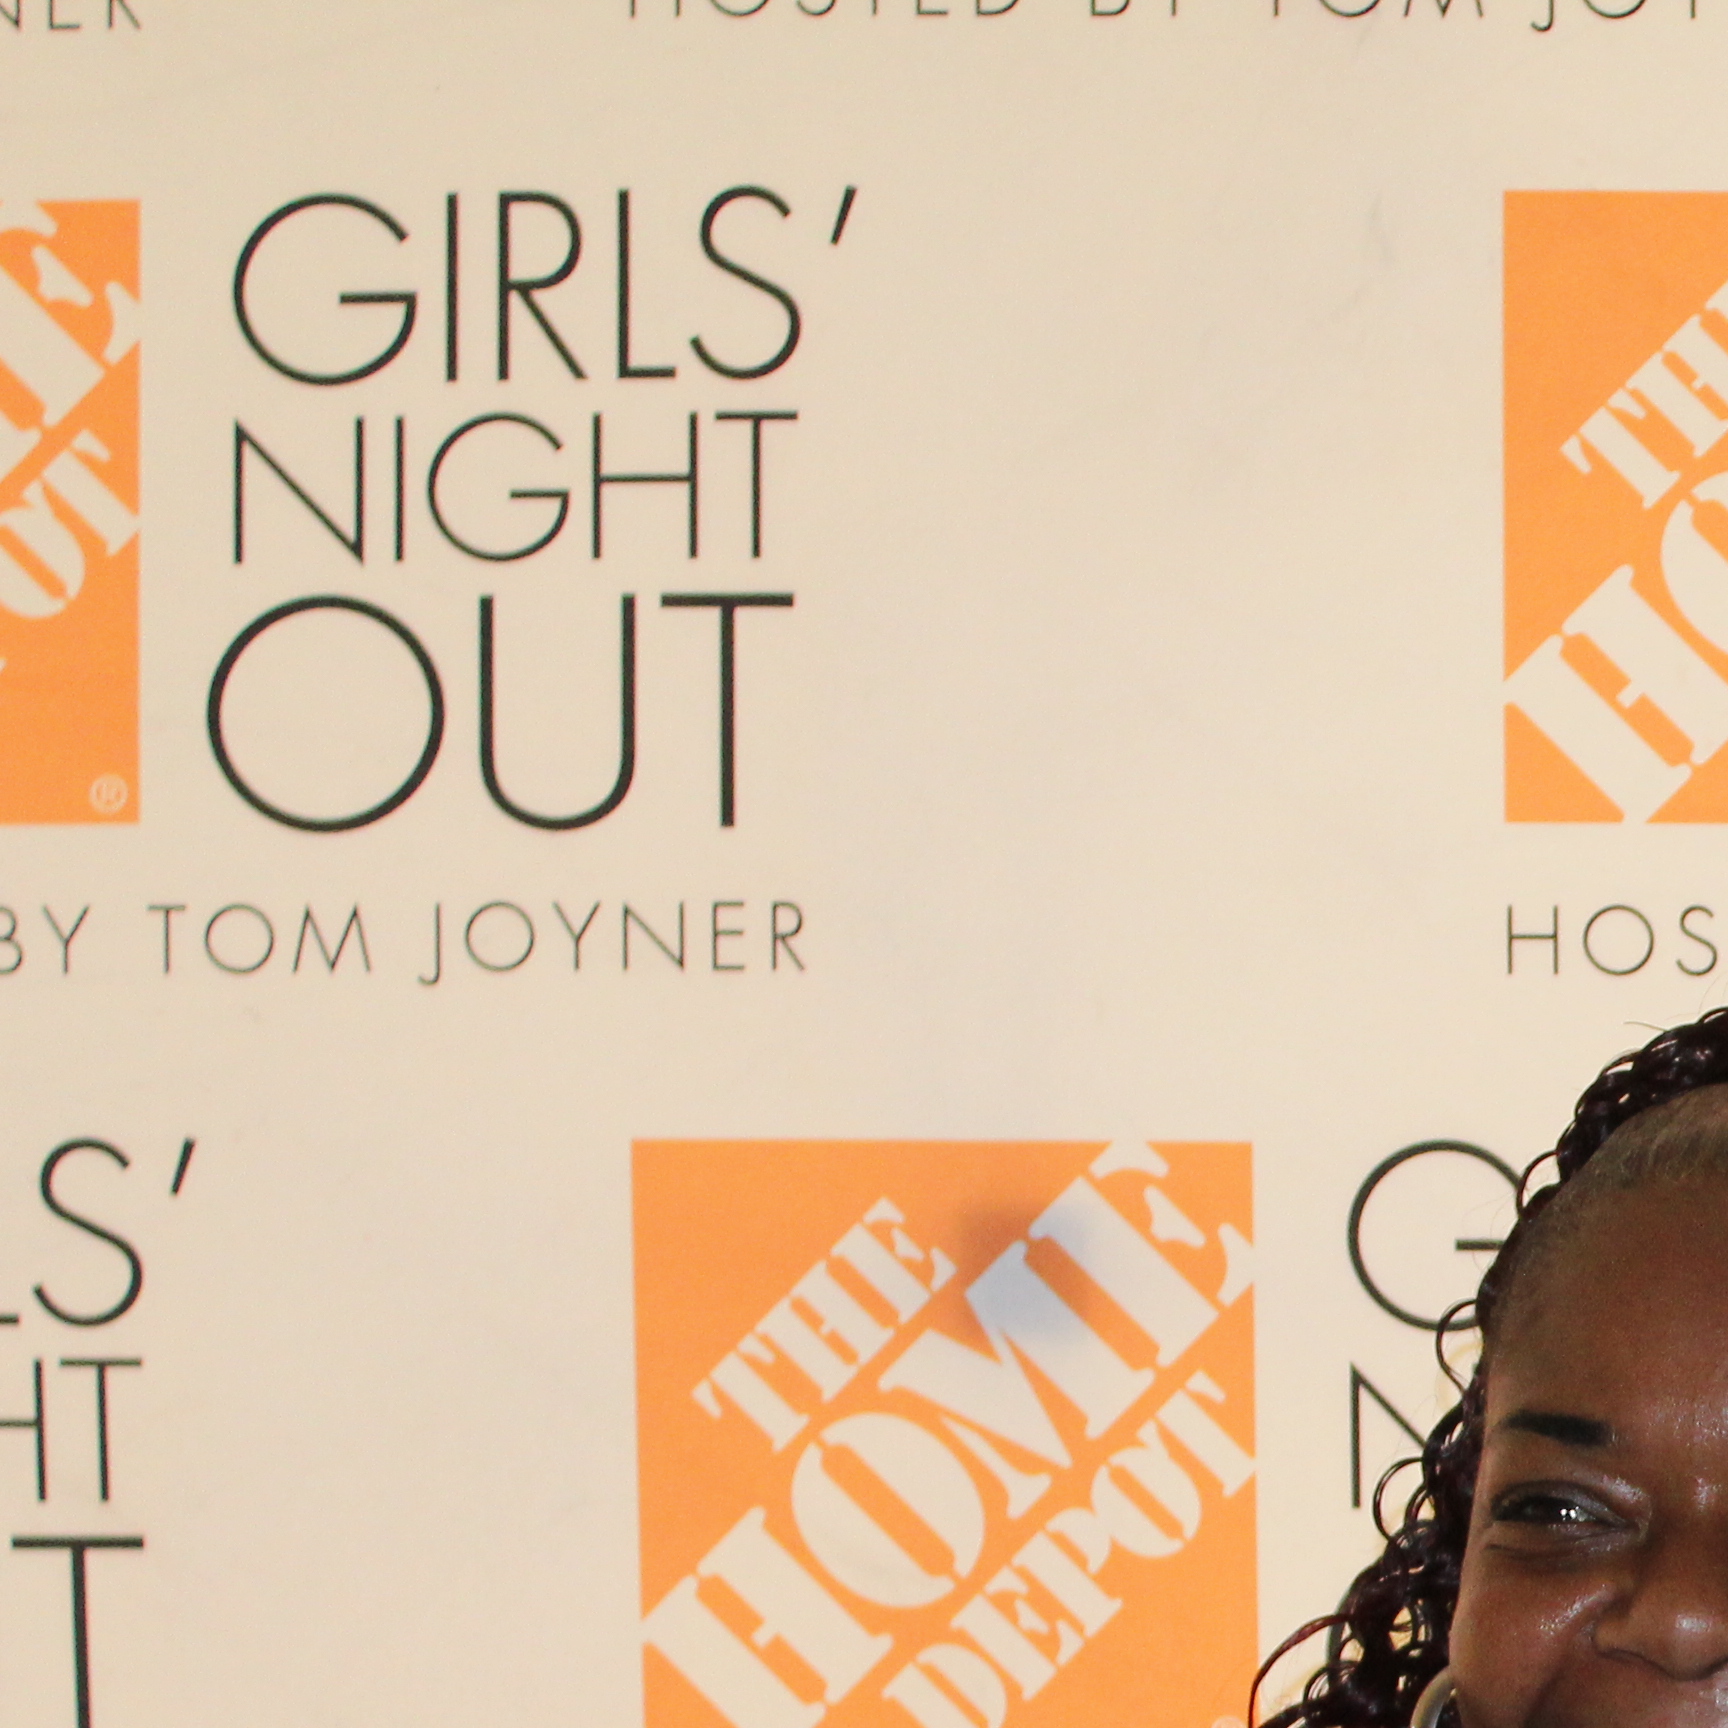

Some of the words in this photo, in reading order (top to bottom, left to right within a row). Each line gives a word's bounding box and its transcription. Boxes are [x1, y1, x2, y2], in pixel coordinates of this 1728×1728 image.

[230, 184, 858, 387] GIRLS'
[232, 410, 799, 565] NIGHT
[206, 591, 795, 834] OUT
[149, 903, 371, 976] TOM
[419, 899, 806, 987] JOYNER
[691, 1196, 958, 1453] THE
